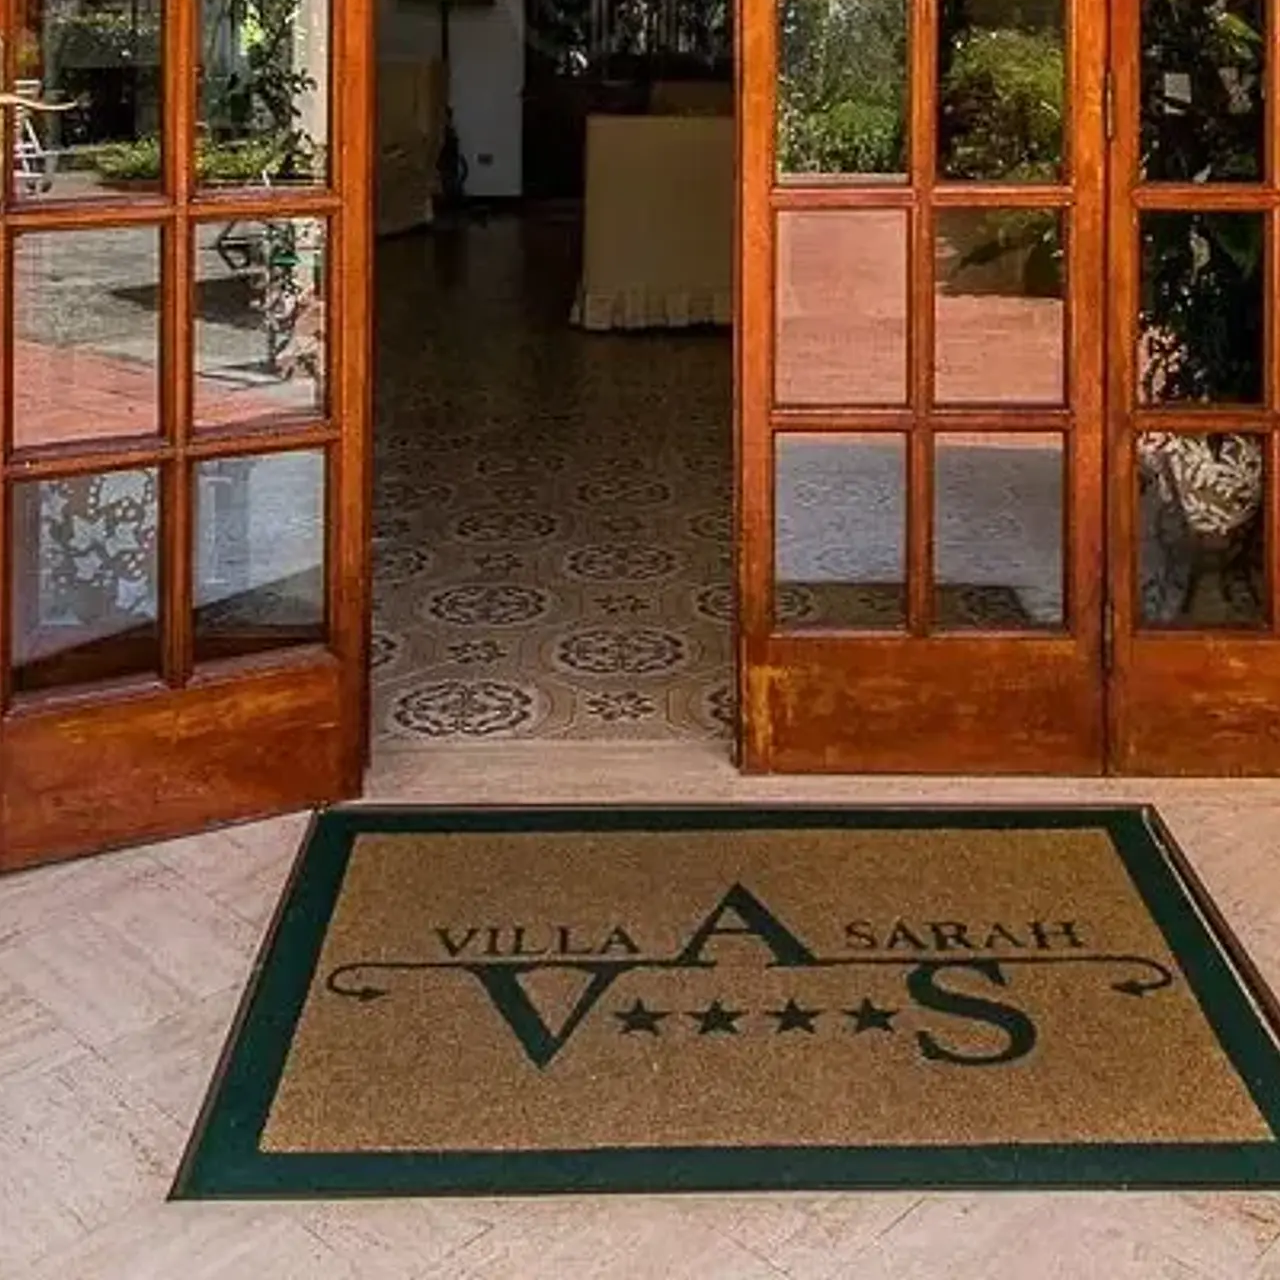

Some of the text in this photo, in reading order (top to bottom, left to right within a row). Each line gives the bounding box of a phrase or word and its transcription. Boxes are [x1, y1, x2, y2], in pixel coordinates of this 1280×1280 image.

[435, 920, 1082, 957] VILLA SARAH
[679, 881, 819, 967] A
[466, 958, 1037, 1070] V S
